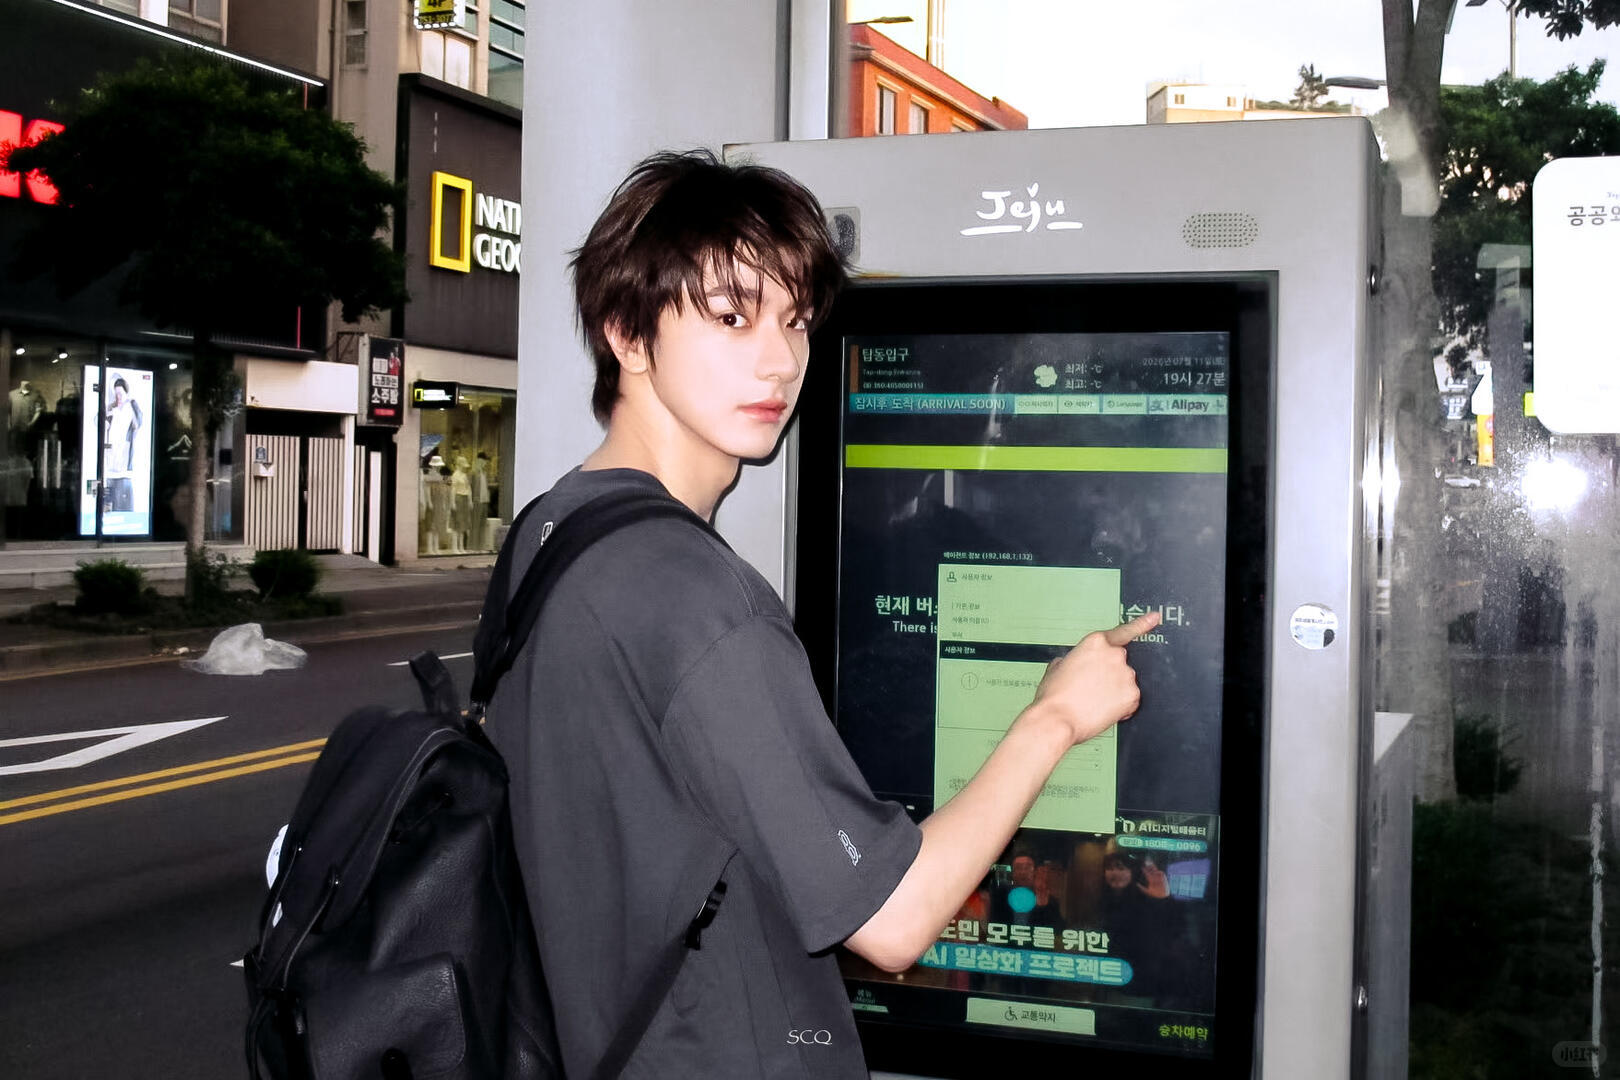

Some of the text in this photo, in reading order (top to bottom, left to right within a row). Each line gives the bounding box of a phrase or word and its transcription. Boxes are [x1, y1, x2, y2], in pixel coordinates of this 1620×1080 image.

[976, 182, 1065, 233] Jeju
[1164, 372, 1226, 387] 19시 27분
[918, 397, 967, 410] (ARRIVAL
[969, 398, 1006, 410] SOON)
[1171, 400, 1209, 411] Alipay
[875, 595, 910, 616] 현재
[892, 620, 927, 633] There
[986, 922, 1055, 949] 모두를
[1062, 929, 1110, 954] 위한
[922, 944, 1122, 983] AI 일상화 프로젝트
[1158, 1024, 1209, 1040] 승차예약
